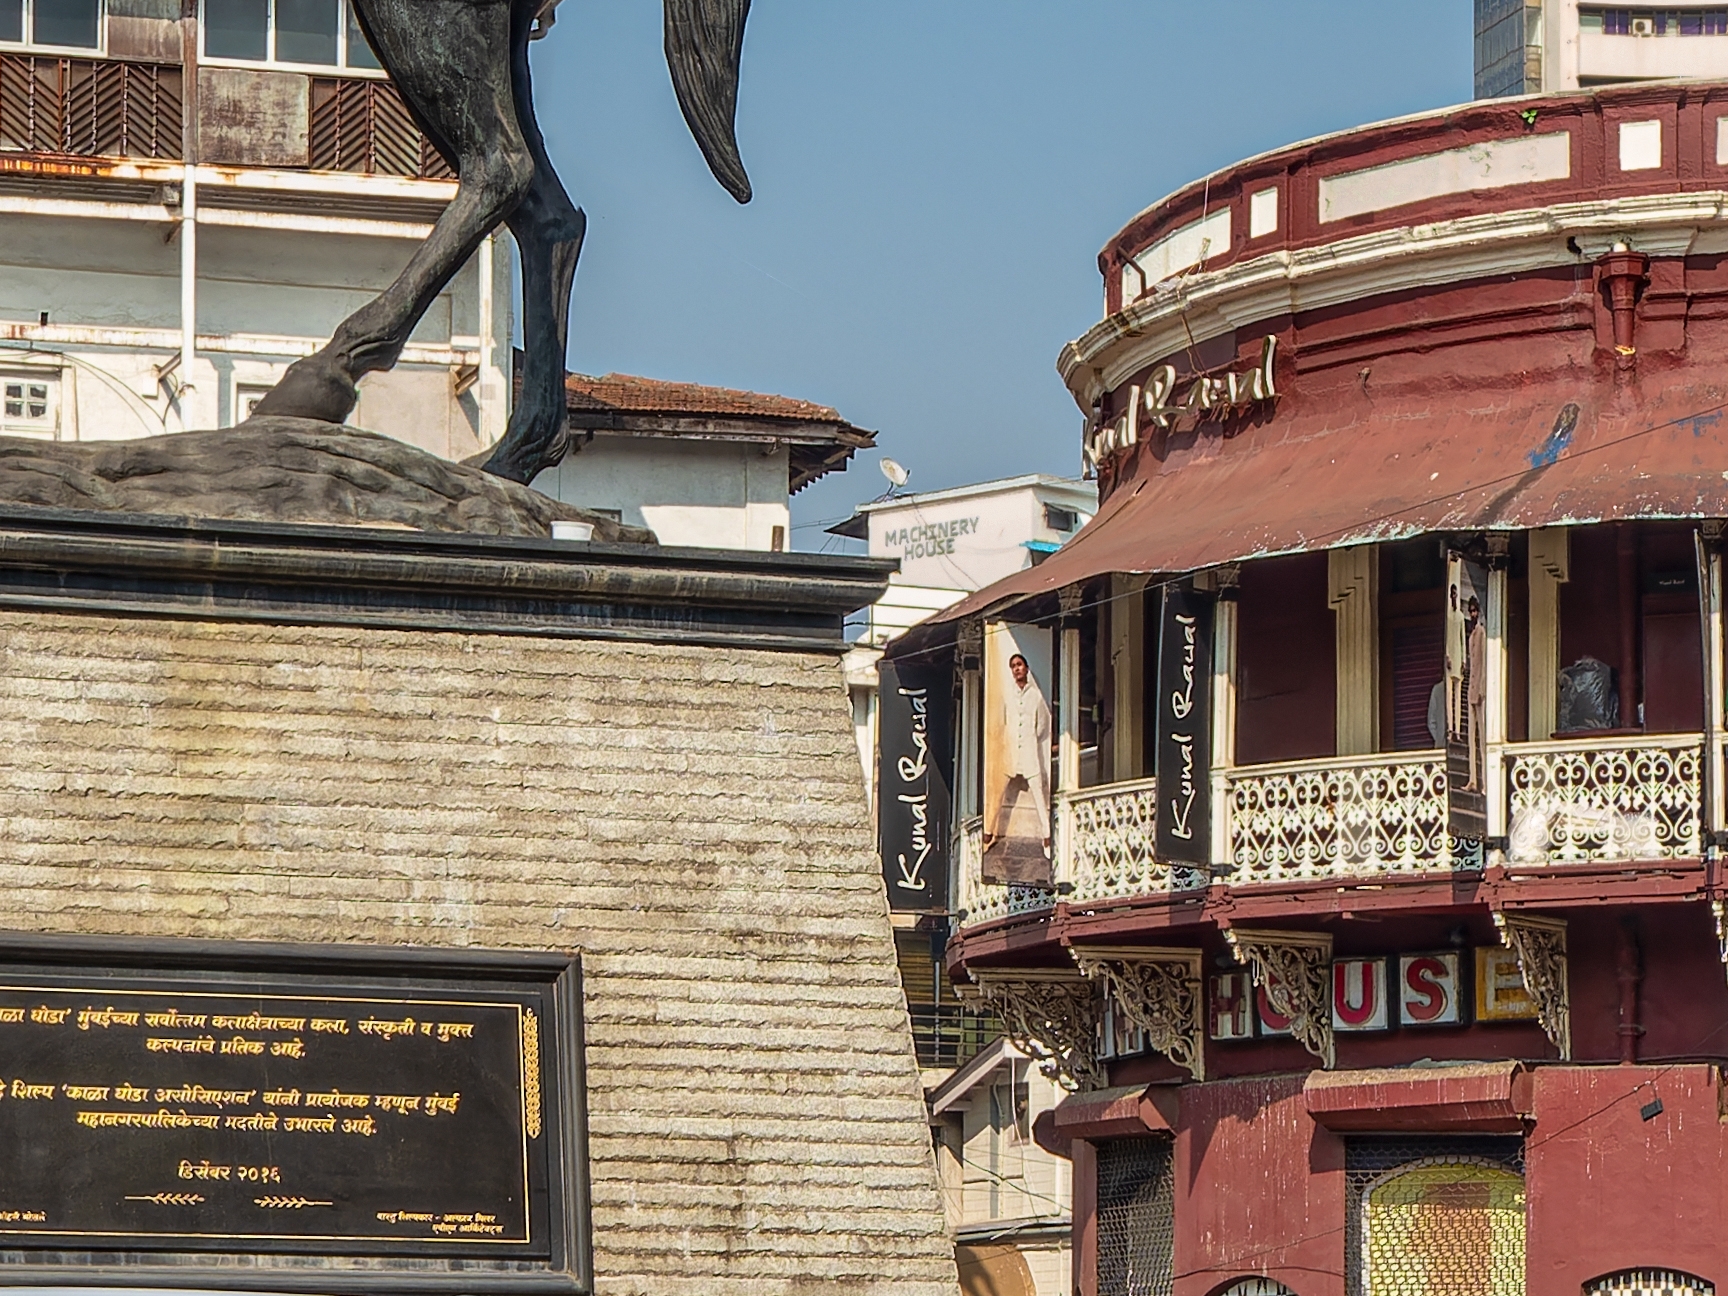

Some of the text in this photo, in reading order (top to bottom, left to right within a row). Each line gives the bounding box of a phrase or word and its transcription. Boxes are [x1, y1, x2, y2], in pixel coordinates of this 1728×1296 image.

[884, 516, 980, 547] MACHINERY
[904, 538, 955, 561] HOUSE
[1171, 614, 1197, 841] Kunal Rawal
[897, 687, 931, 891] Kunal Rawal
[421, 1022, 432, 1036] व
[11, 1079, 55, 1100] शिल्प
[114, 1082, 149, 1102] घोडा
[262, 1087, 301, 1106] यांनी
[305, 1088, 370, 1109] प्रायोजक
[375, 1093, 421, 1116] म्हणून
[425, 1092, 461, 1117] मुंबई
[224, 1111, 279, 1132] मदतीने
[284, 1113, 335, 1133] उभारले
